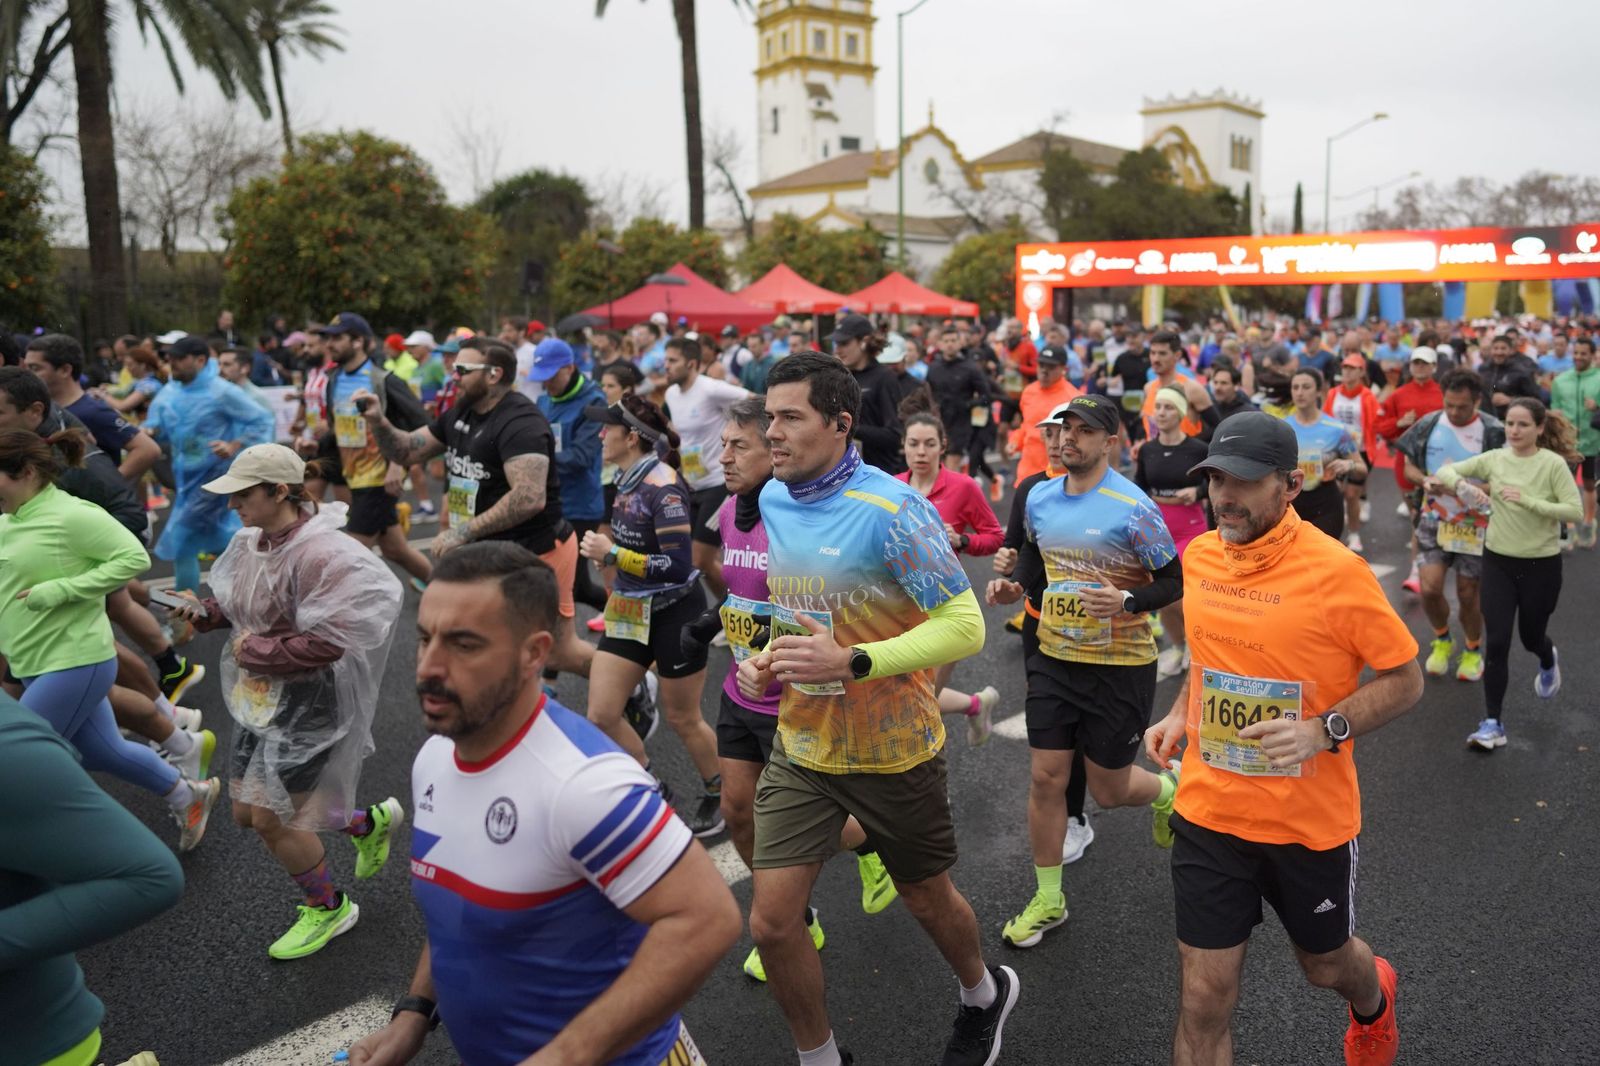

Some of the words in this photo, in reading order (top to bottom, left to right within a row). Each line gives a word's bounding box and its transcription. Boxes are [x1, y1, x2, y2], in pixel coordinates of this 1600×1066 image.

[818, 545, 842, 557] HOKA
[1200, 579, 1246, 599] RUNNING
[1249, 590, 1281, 605] CLUB
[1206, 631, 1237, 647] HOLMES
[1238, 639, 1265, 653] PLACE
